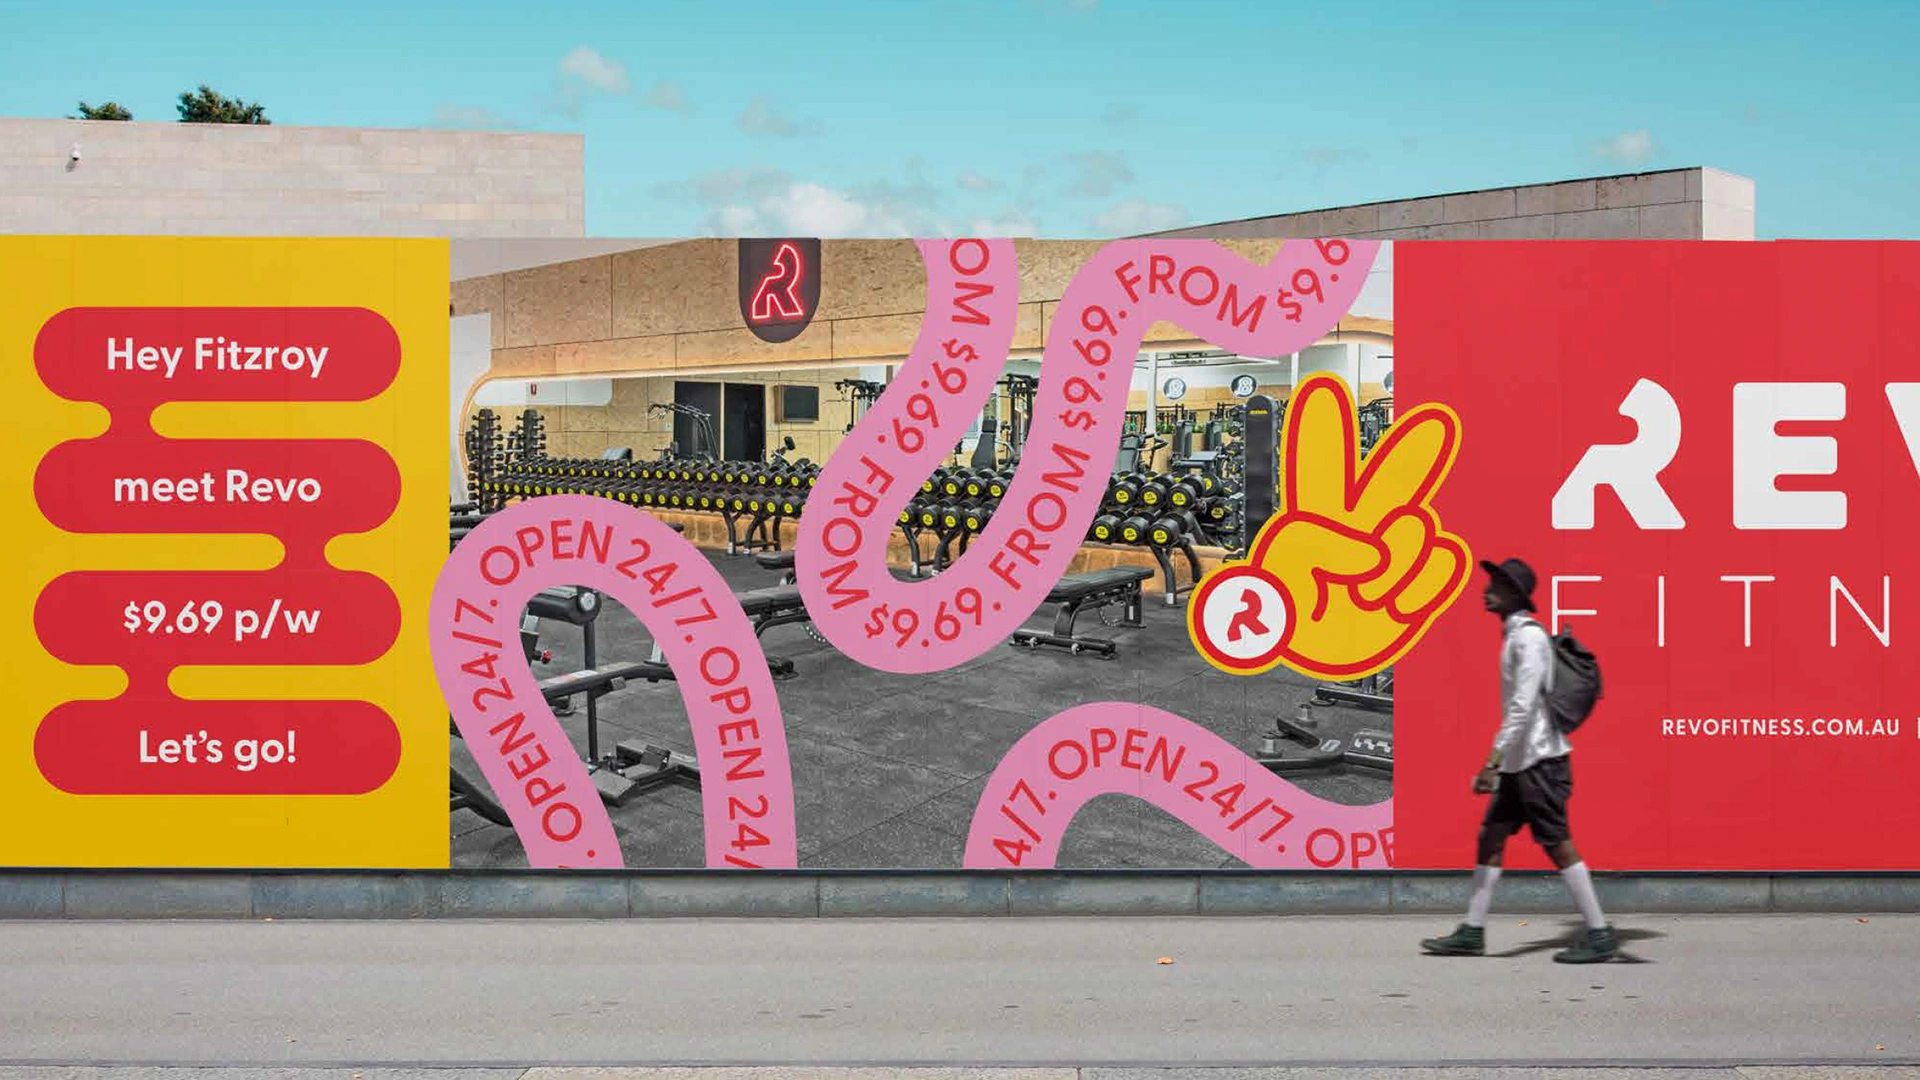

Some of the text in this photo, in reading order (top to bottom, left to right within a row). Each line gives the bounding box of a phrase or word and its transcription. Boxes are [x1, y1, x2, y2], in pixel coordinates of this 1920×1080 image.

[1114, 254, 1267, 333] FROM
[107, 336, 329, 379] Hey Fitzroy
[878, 338, 979, 454] $9.69.
[1058, 305, 1127, 431] $9.69.
[114, 469, 322, 502] meet Revo
[1551, 377, 1920, 530] RE
[479, 519, 614, 586] OPEN
[820, 456, 895, 610] FROM
[989, 444, 1091, 590] FROM
[123, 597, 322, 643] $9.69 p/w
[615, 537, 719, 644] 24/7.
[864, 588, 1001, 649] $9.69.
[451, 598, 515, 713] 24/7.
[139, 729, 296, 772] Let’s go!
[699, 646, 765, 782] OPEN
[1662, 718, 1900, 736] REVOFITNESS.COM.AU
[489, 711, 583, 843] OPEN
[1047, 727, 1186, 783] OPEN
[1183, 760, 1295, 854] 24/7.
